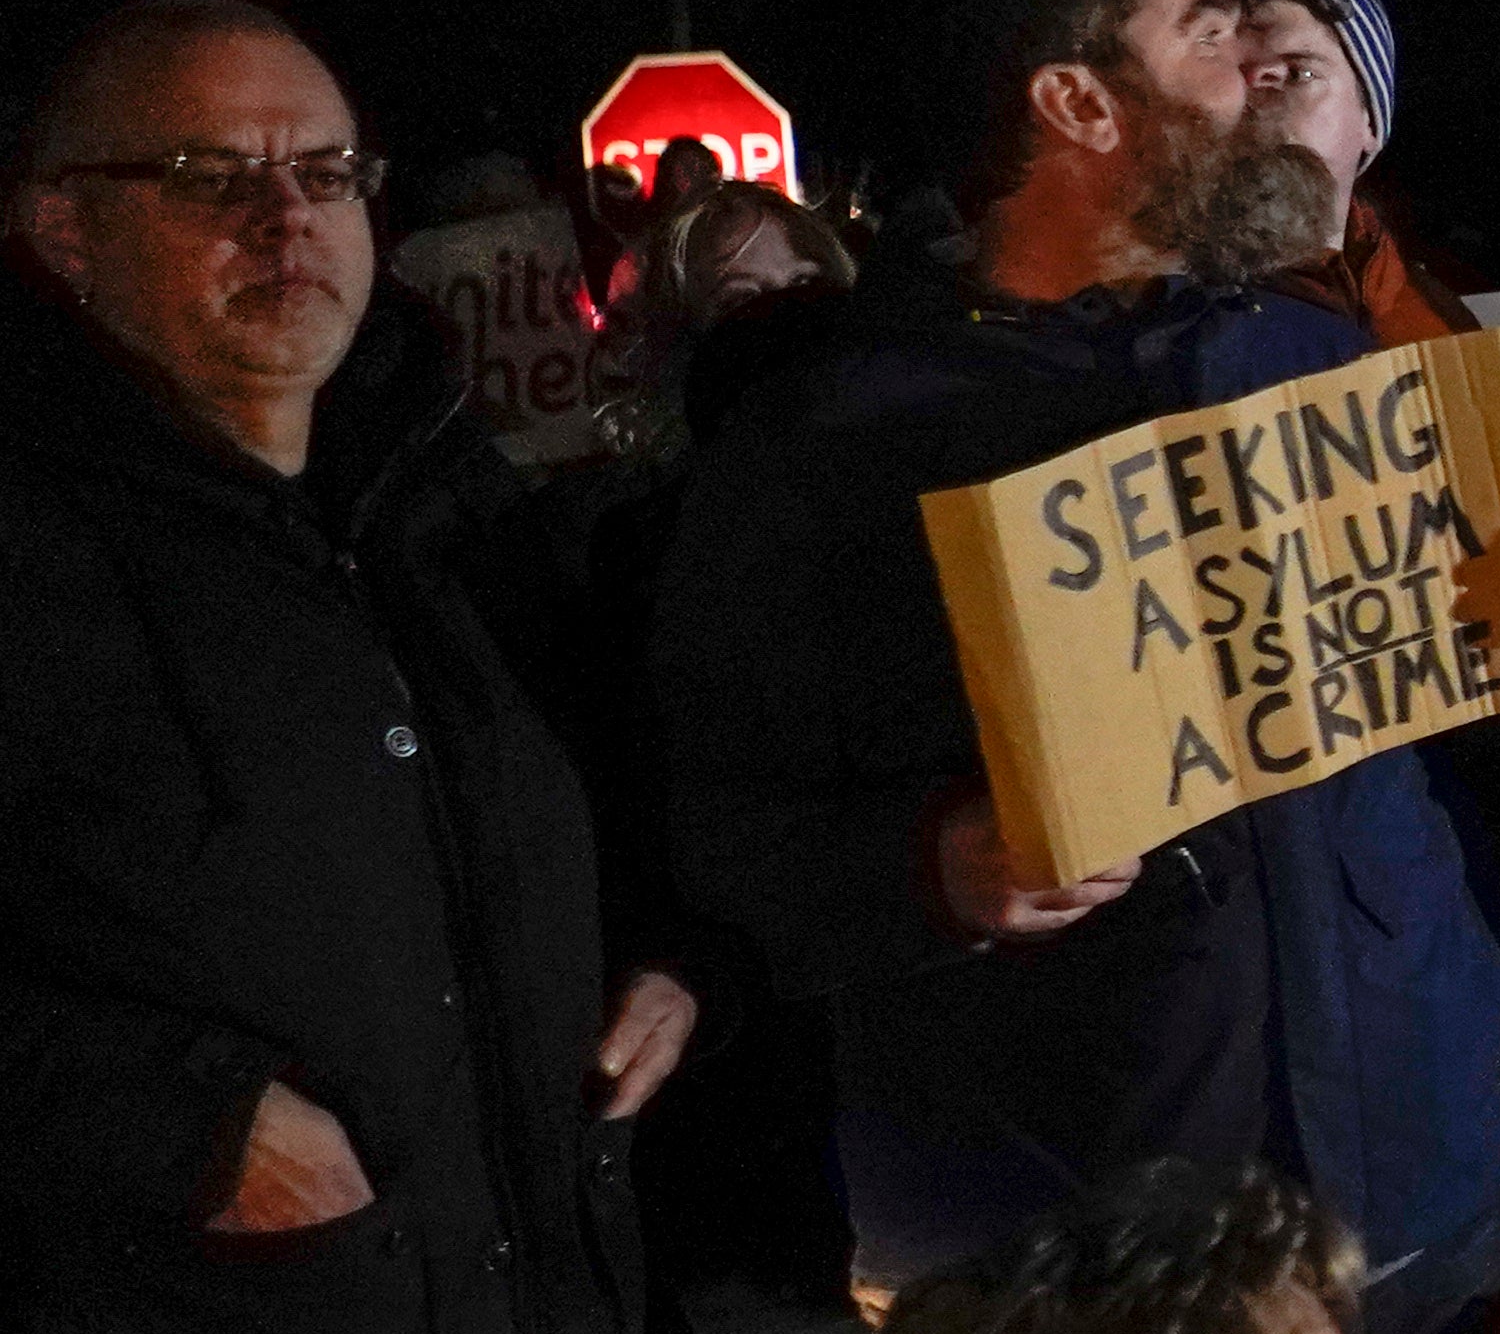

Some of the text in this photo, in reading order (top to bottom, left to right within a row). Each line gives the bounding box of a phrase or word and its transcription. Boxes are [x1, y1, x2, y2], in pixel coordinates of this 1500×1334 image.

[1042, 370, 1441, 592] SEEKING
[1131, 484, 1486, 672] ASYLUM
[1211, 566, 1440, 700] IS NOT
[1167, 714, 1232, 806] A
